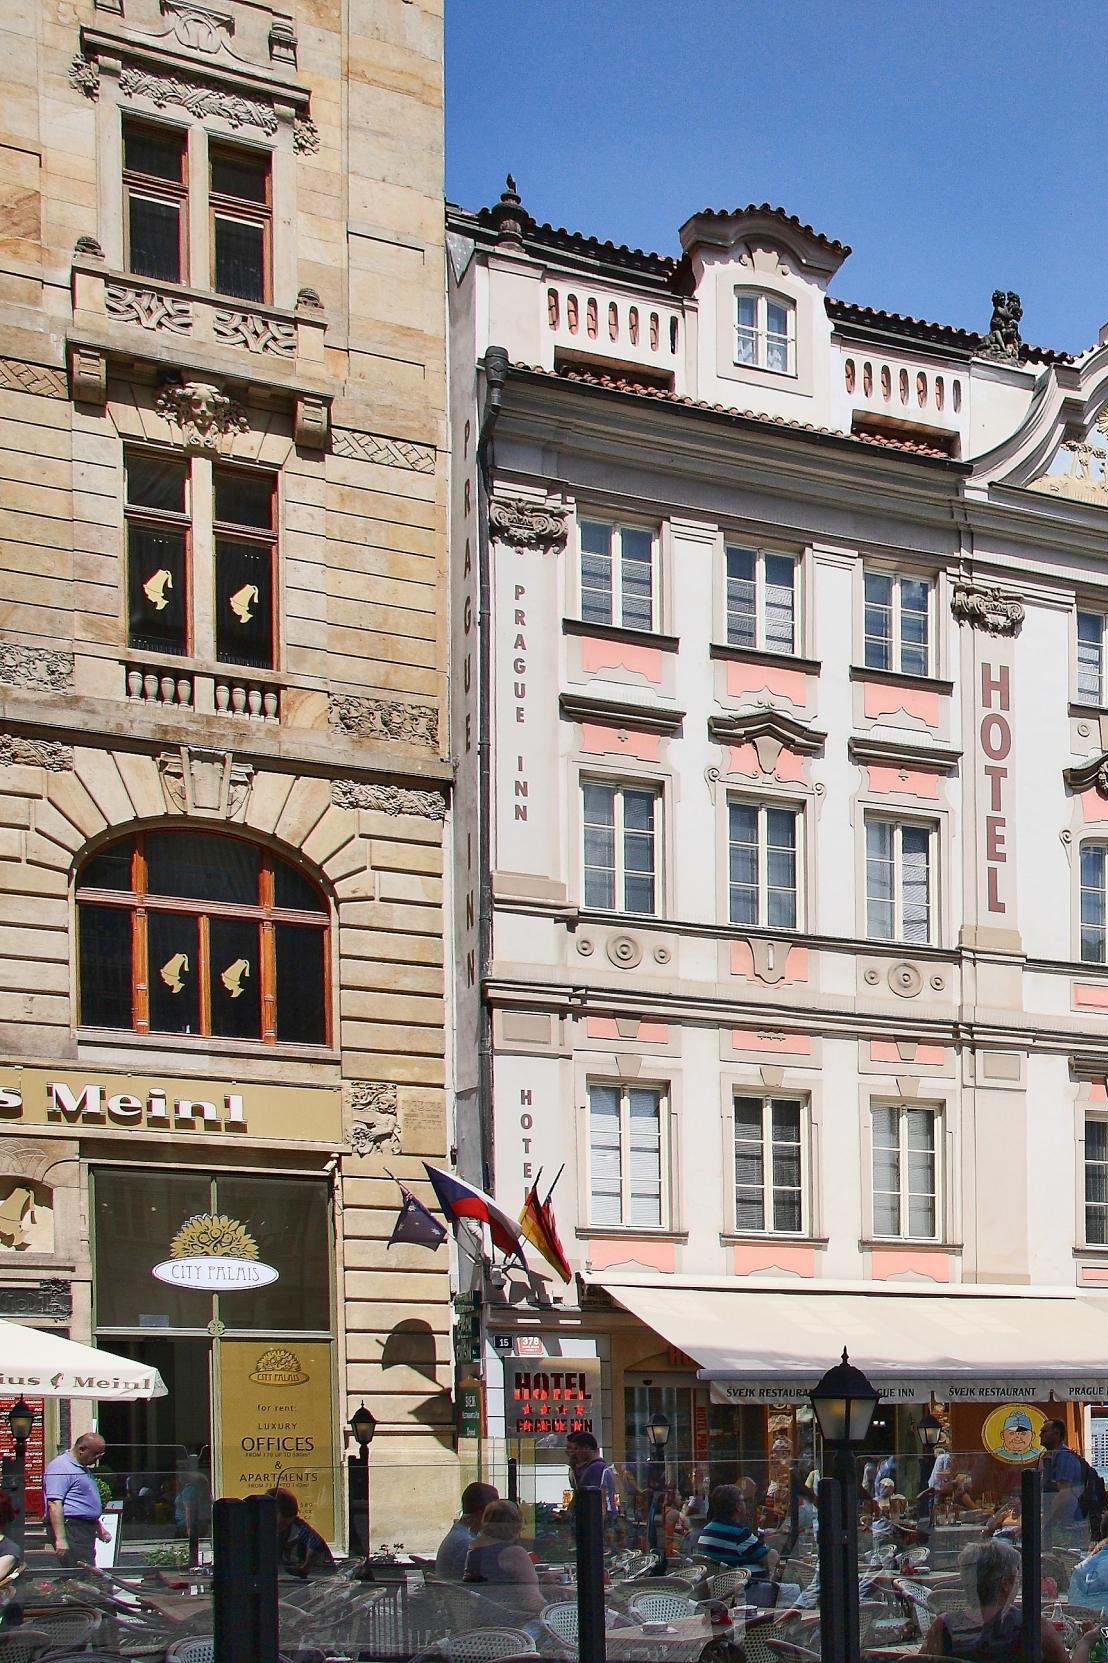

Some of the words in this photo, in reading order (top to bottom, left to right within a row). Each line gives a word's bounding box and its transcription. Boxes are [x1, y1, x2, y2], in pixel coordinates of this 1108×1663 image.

[513, 584, 527, 723] PRAGUE
[514, 755, 529, 822] INN
[980, 661, 1011, 914] HOTEL
[46, 1081, 248, 1131] Meinl
[171, 1264, 202, 1280] CITY
[208, 1265, 260, 1282] PALAIS
[499, 1338, 509, 1347] 15
[522, 1337, 540, 1345] 378
[257, 1373, 272, 1381] CITY
[274, 1373, 300, 1382] PALAIS
[73, 1377, 151, 1390] Meinl
[515, 1372, 592, 1399] HOTEL
[726, 1387, 756, 1397] ŠVEJK
[758, 1388, 812, 1398] RESTAURA
[898, 1389, 915, 1397] INN
[949, 1386, 976, 1397] ŠVEJK
[978, 1387, 1037, 1397] RESTAURANT
[1068, 1387, 1104, 1396] PRAGUE
[257, 1404, 271, 1412] for
[258, 1422, 297, 1430] LUXURY
[241, 1436, 315, 1452] OFFICES
[274, 1460, 282, 1469] &
[240, 1472, 318, 1482] APARTMENTS
